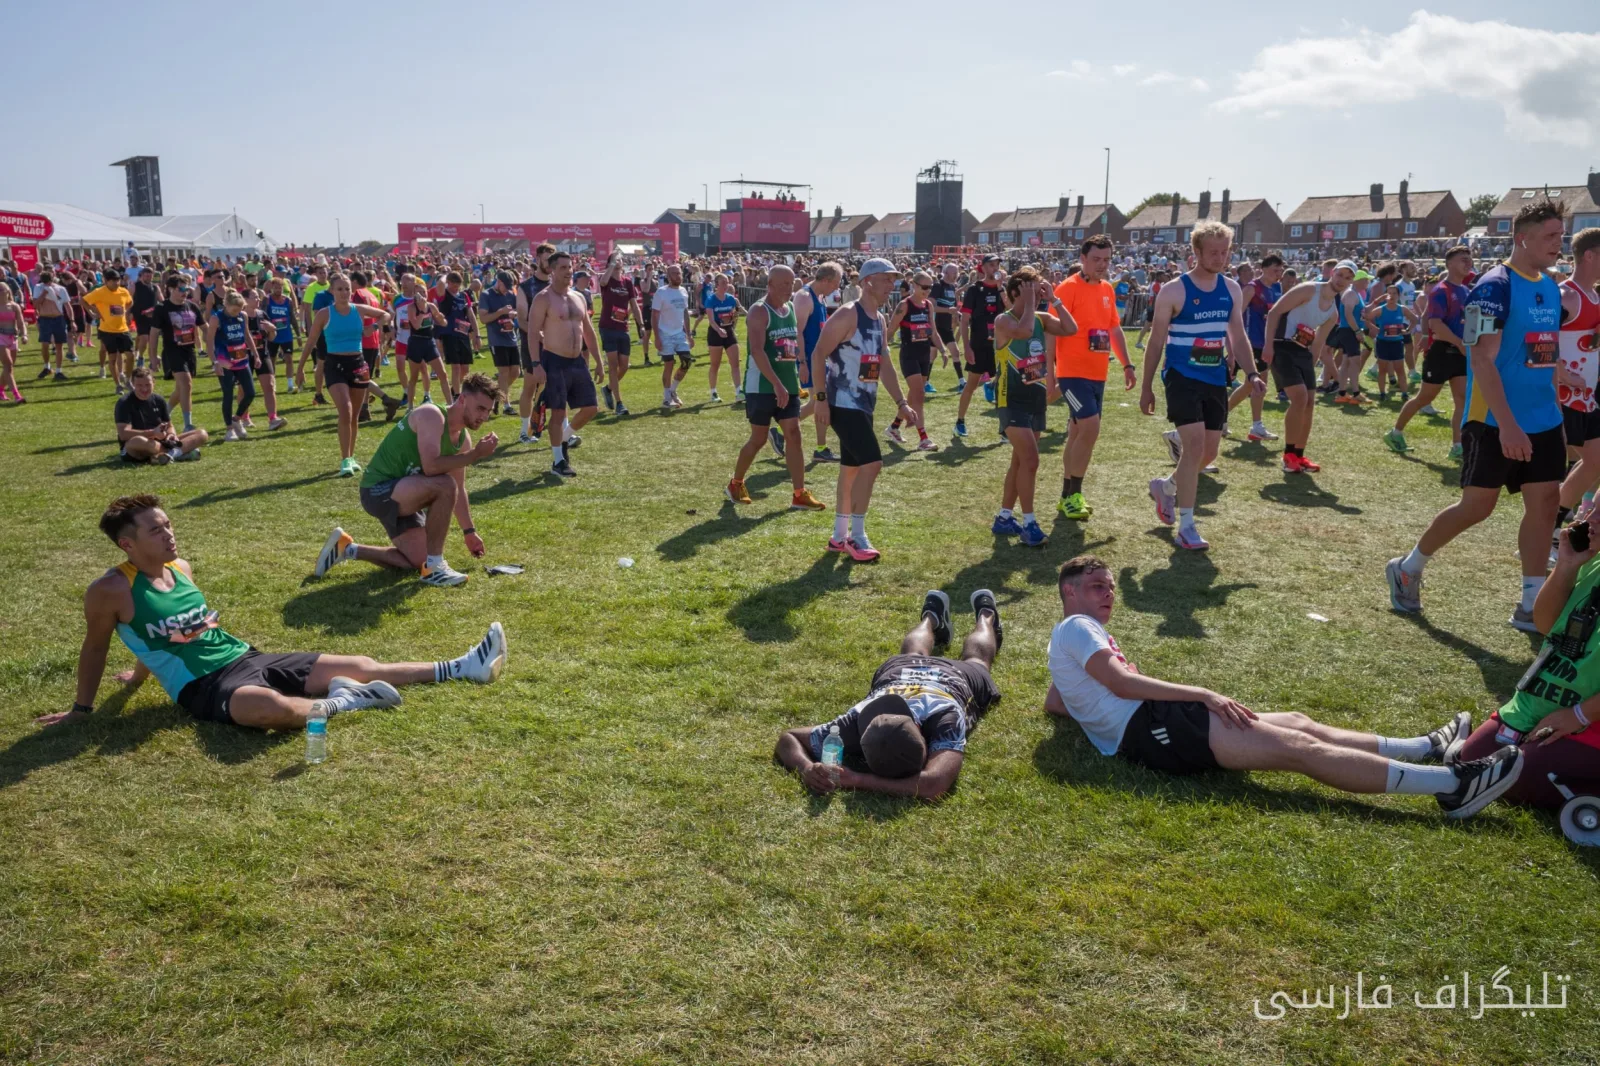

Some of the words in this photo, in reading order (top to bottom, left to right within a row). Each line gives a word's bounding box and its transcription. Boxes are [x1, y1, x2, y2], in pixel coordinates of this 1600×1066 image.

[0, 215, 45, 228] OSPITALITY
[13, 224, 46, 236] VILLAGE
[1194, 310, 1229, 320] MORPETH
[227, 324, 242, 332] BETH
[145, 604, 208, 638] NSPCC
